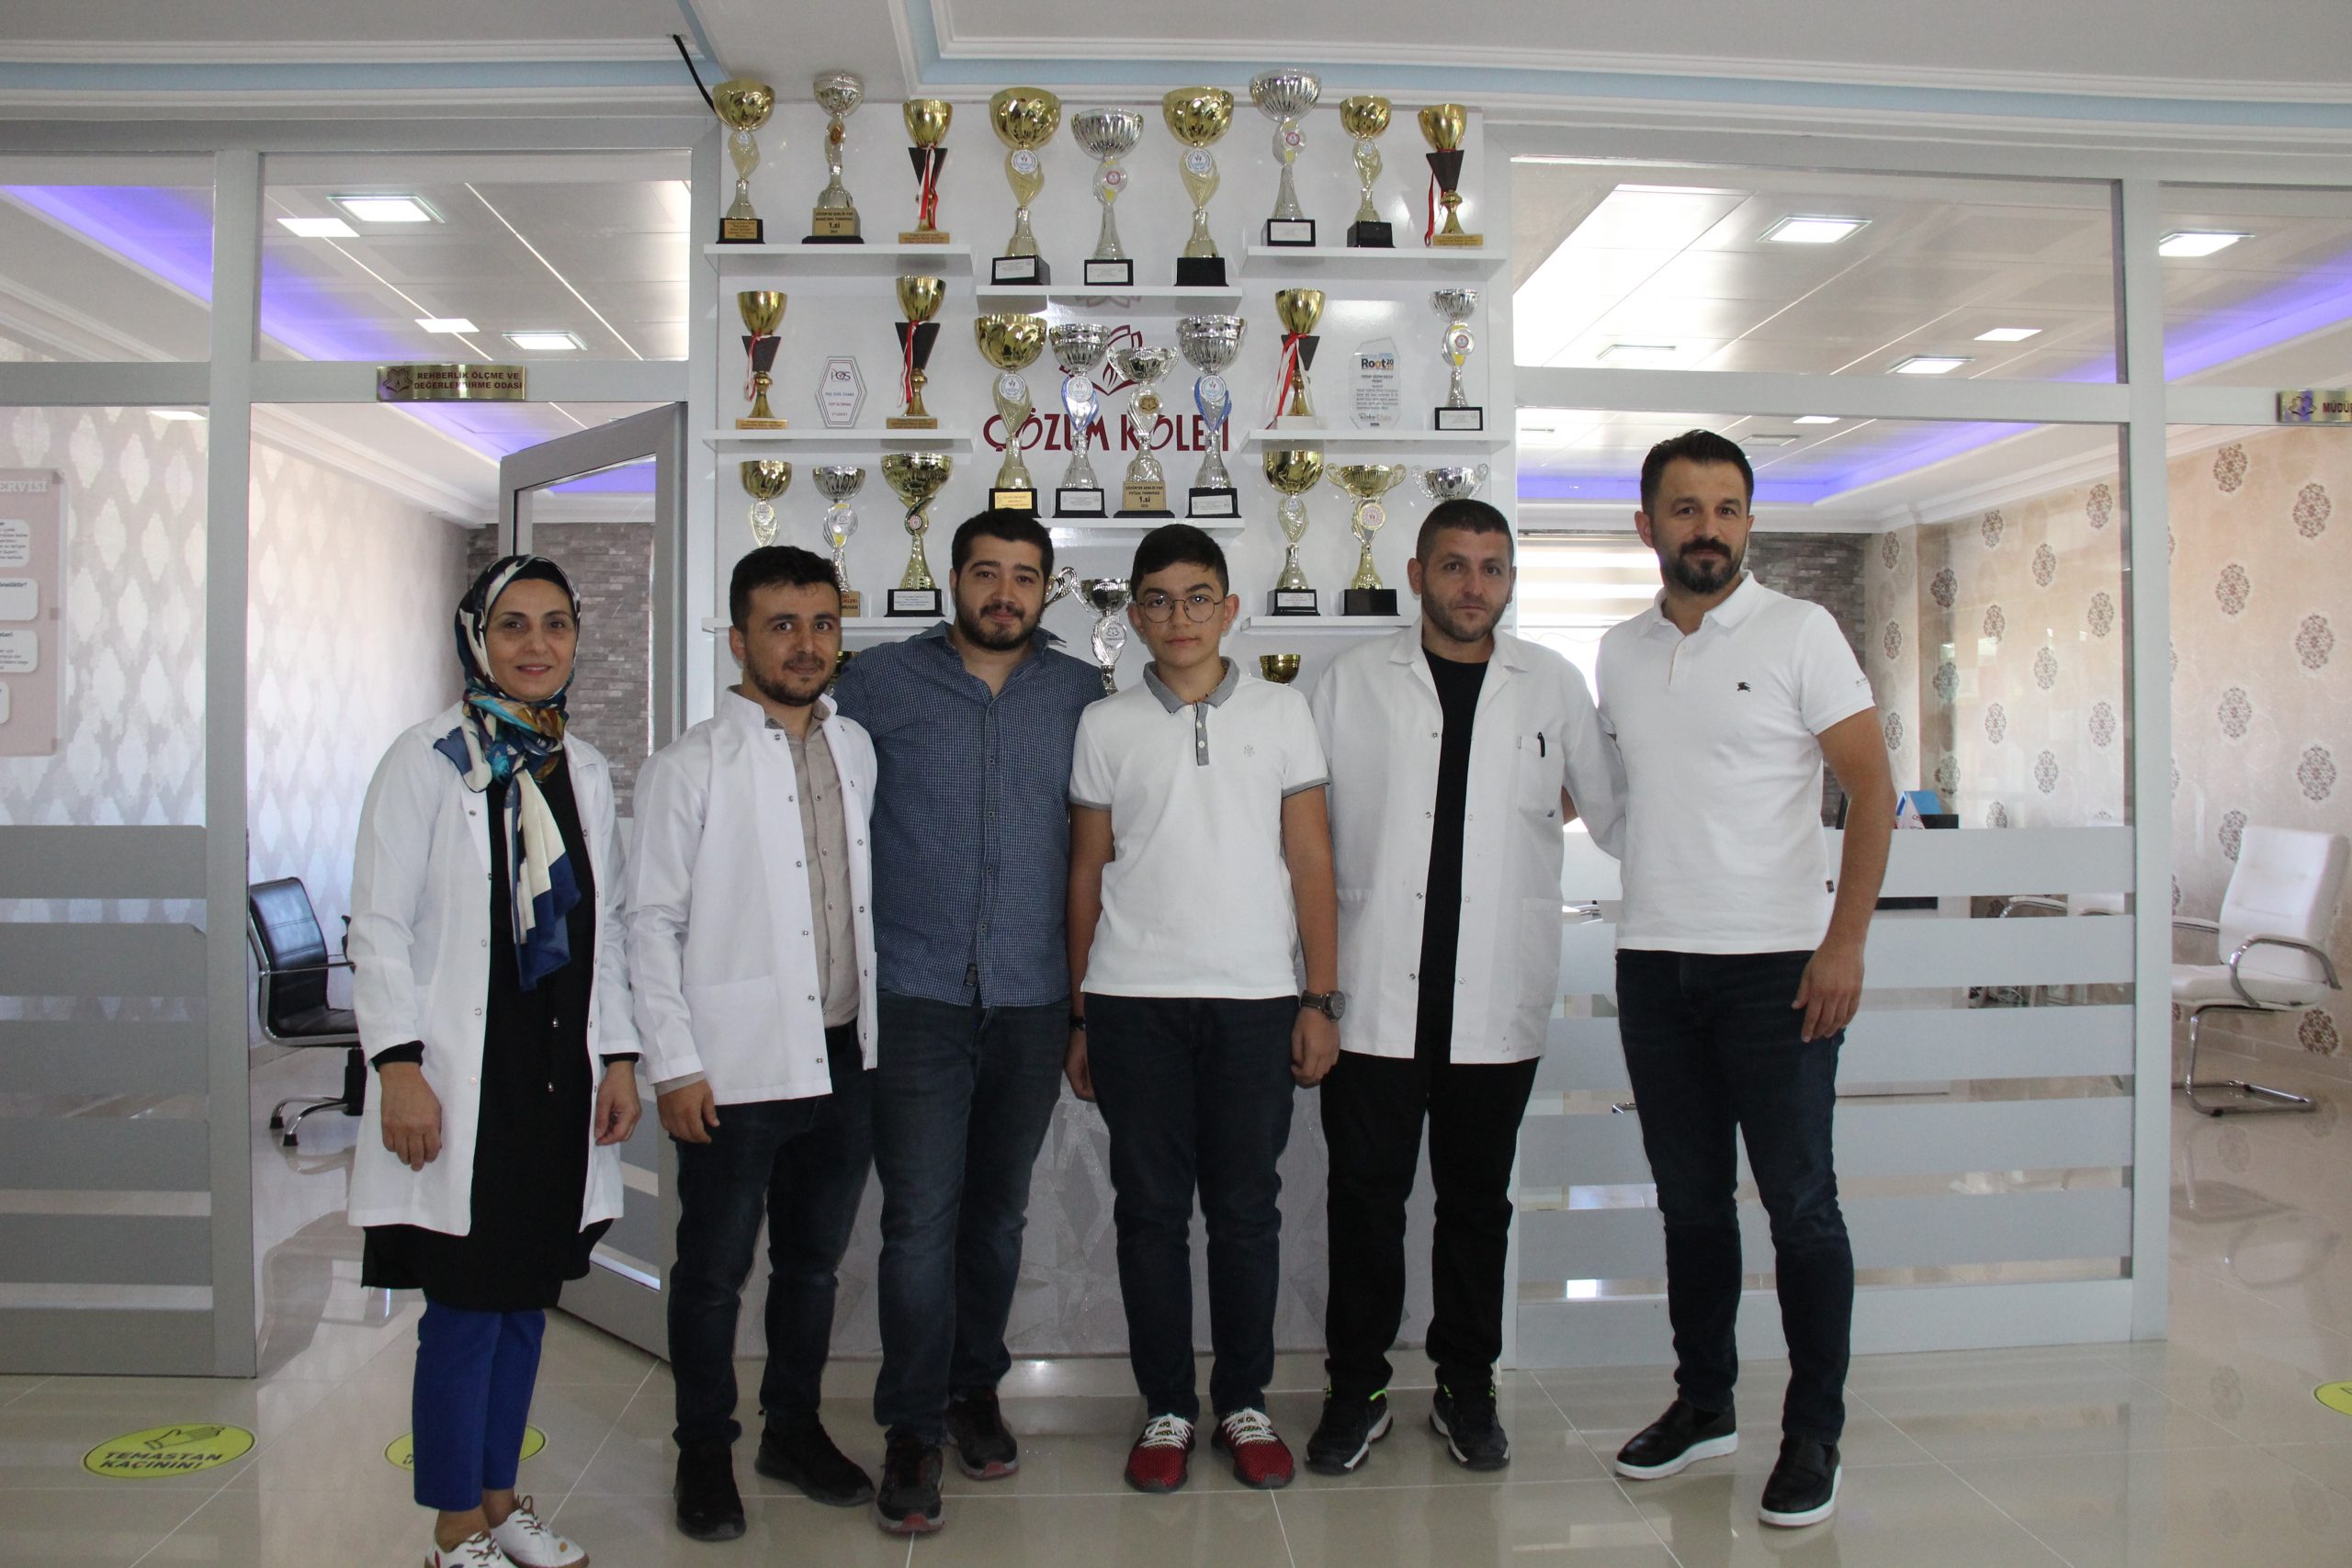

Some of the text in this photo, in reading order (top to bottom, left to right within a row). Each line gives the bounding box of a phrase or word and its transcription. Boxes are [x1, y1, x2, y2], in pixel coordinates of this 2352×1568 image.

[1361, 358, 1386, 368] Root
[494, 381, 523, 389] ODASI
[1121, 413, 1229, 452] KOLEİ
[105, 1451, 223, 1461] TEMASTAN
[99, 1460, 204, 1469] KAÇININ!
